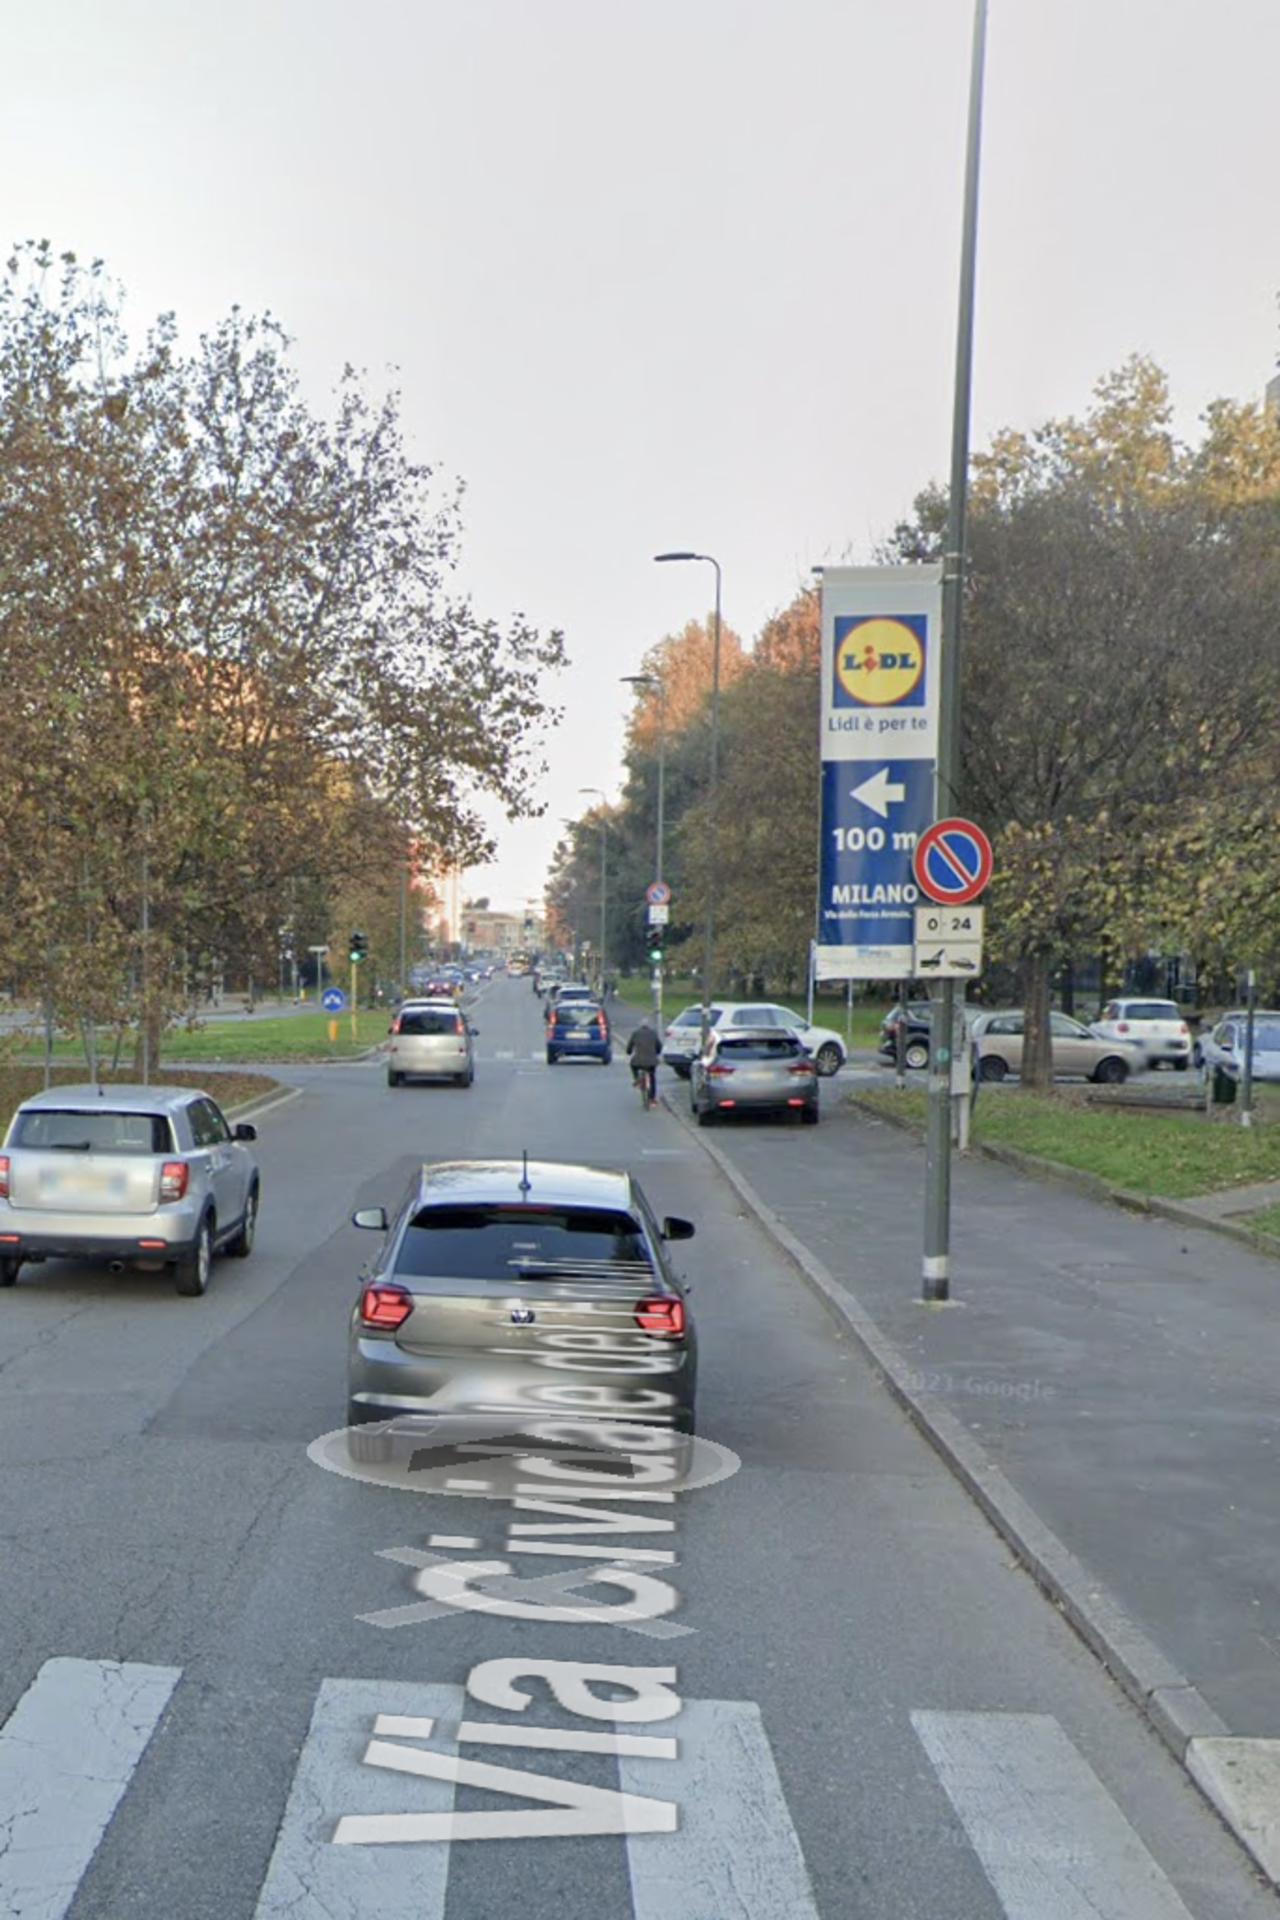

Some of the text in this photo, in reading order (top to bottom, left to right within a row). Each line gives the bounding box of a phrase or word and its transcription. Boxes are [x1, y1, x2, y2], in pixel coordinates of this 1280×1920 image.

[828, 716, 928, 733] Lidl è per te
[832, 827, 917, 851] 100 m
[832, 884, 919, 904] MILANO
[927, 918, 938, 930] 0
[951, 918, 972, 930] 24
